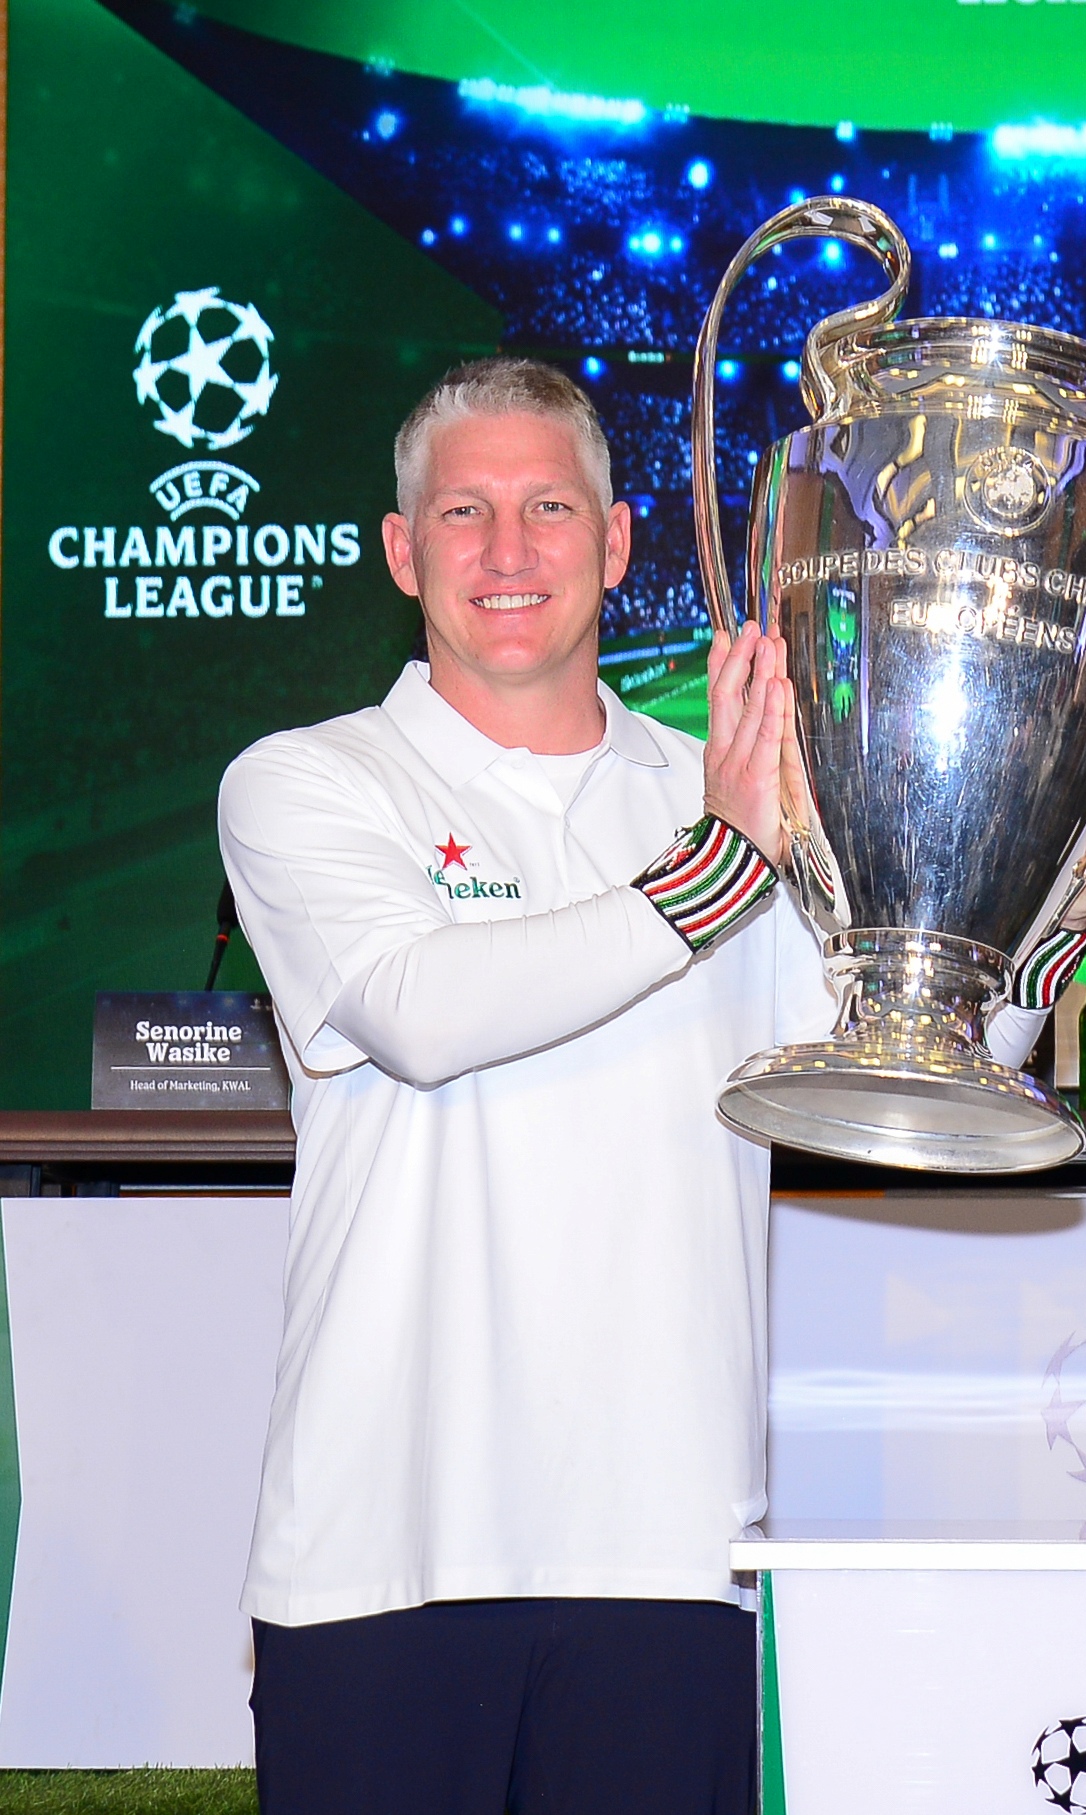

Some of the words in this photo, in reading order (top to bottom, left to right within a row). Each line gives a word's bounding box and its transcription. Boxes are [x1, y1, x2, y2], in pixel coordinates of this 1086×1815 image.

[155, 468, 249, 513] UEFA
[48, 524, 361, 569] CHAMPIONS
[778, 550, 860, 589] COUPE
[862, 547, 927, 576] DES
[933, 547, 1041, 590] CLUBS
[104, 575, 306, 617] LEAGUE
[890, 599, 1077, 654] EUOPÉENS
[135, 1020, 242, 1042] Senorine
[146, 1042, 231, 1062] Wasike
[130, 1080, 156, 1091] Head
[157, 1080, 169, 1091] of
[169, 1080, 221, 1092] Marketing,
[222, 1080, 251, 1091] KWAL
